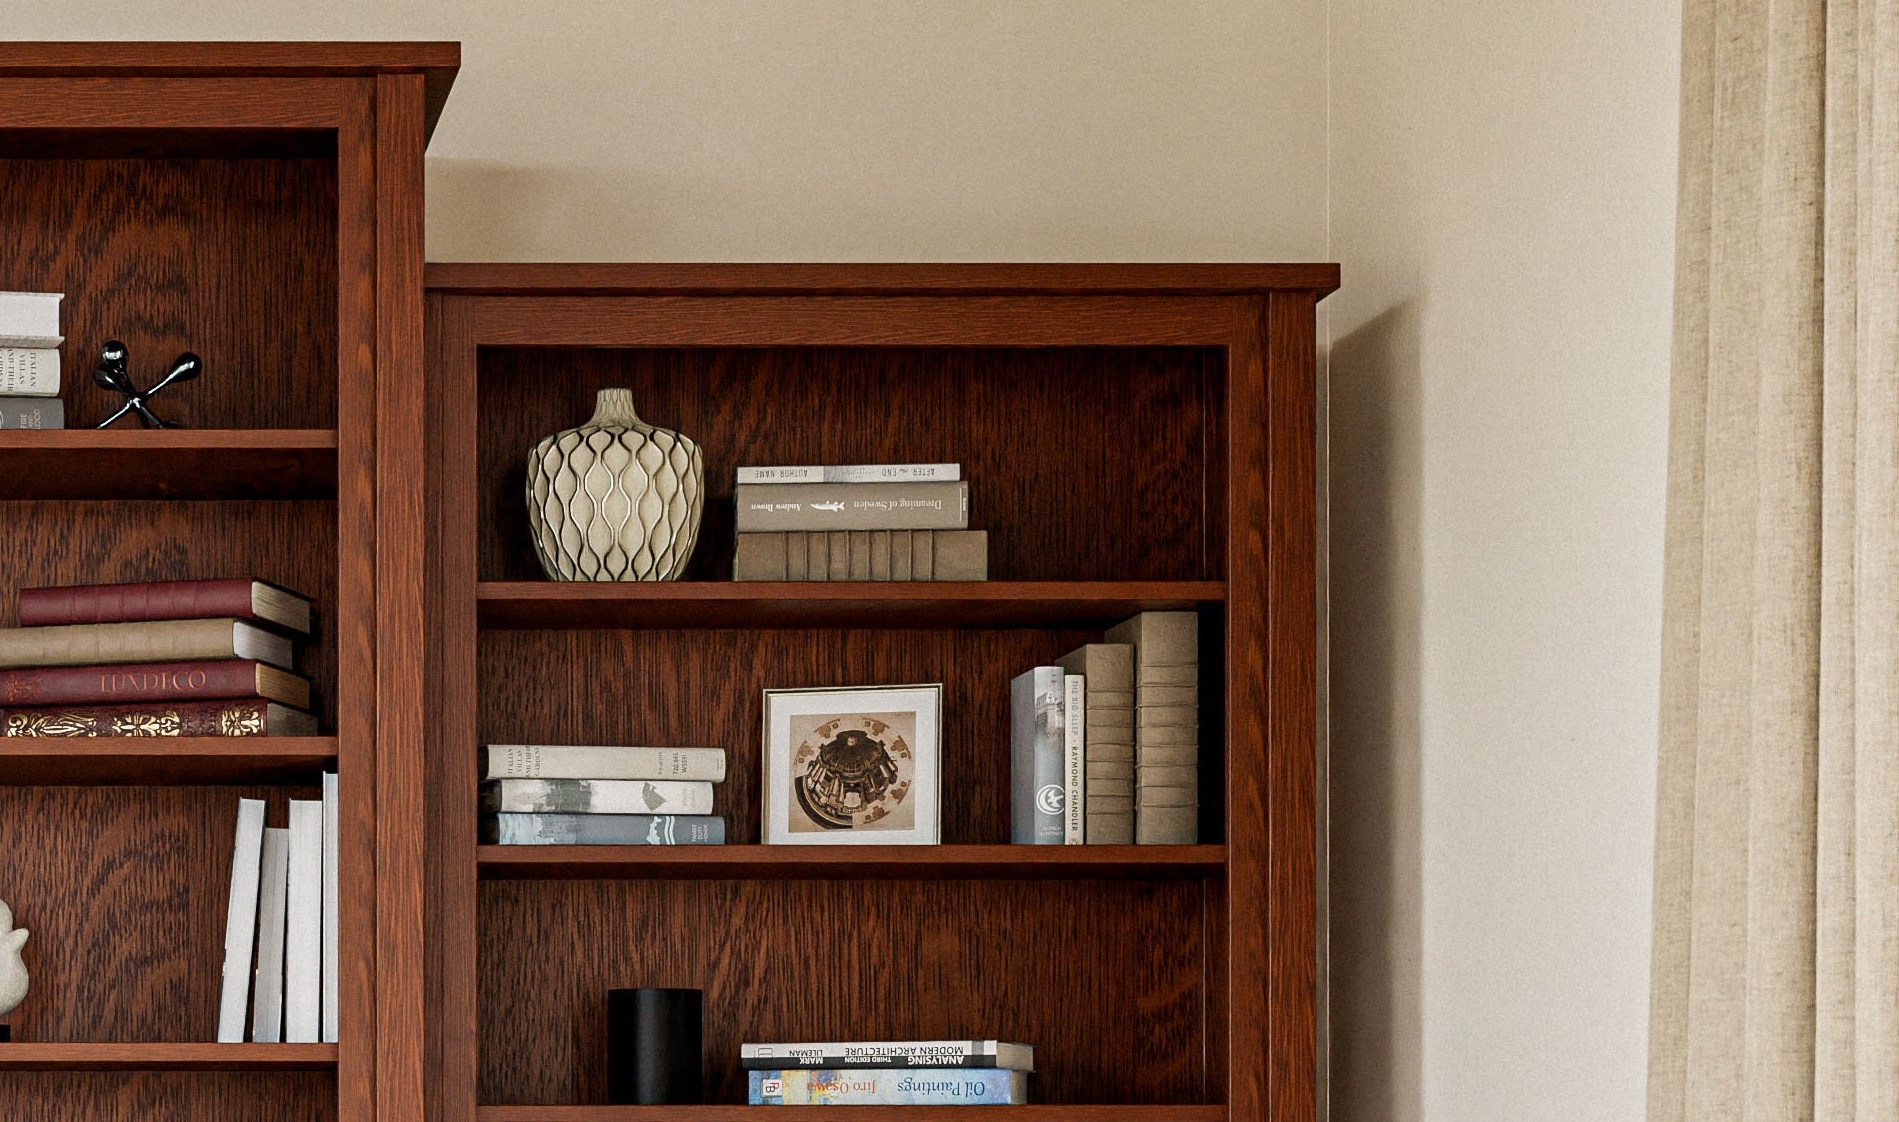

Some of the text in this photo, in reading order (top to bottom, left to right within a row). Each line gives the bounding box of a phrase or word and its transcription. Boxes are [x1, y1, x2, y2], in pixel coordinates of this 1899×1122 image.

[755, 469, 808, 478] AUTHOR NAME
[882, 469, 897, 477] END
[913, 468, 935, 477] AFTER
[751, 502, 802, 512] Andrew Brown
[853, 500, 888, 511] Sweden
[900, 498, 942, 510] Dreaming
[102, 670, 207, 694] LUXDECO
[789, 1049, 824, 1058] LILEMAN
[845, 1046, 964, 1057] MODERN ARCHITECTURE
[800, 1056, 824, 1065] MARK
[844, 1055, 892, 1063] THIRD EDITION
[908, 1055, 964, 1065] ANALYSING
[807, 1080, 876, 1094] Jiro Osawa
[897, 1077, 985, 1097] Oil Paintings
